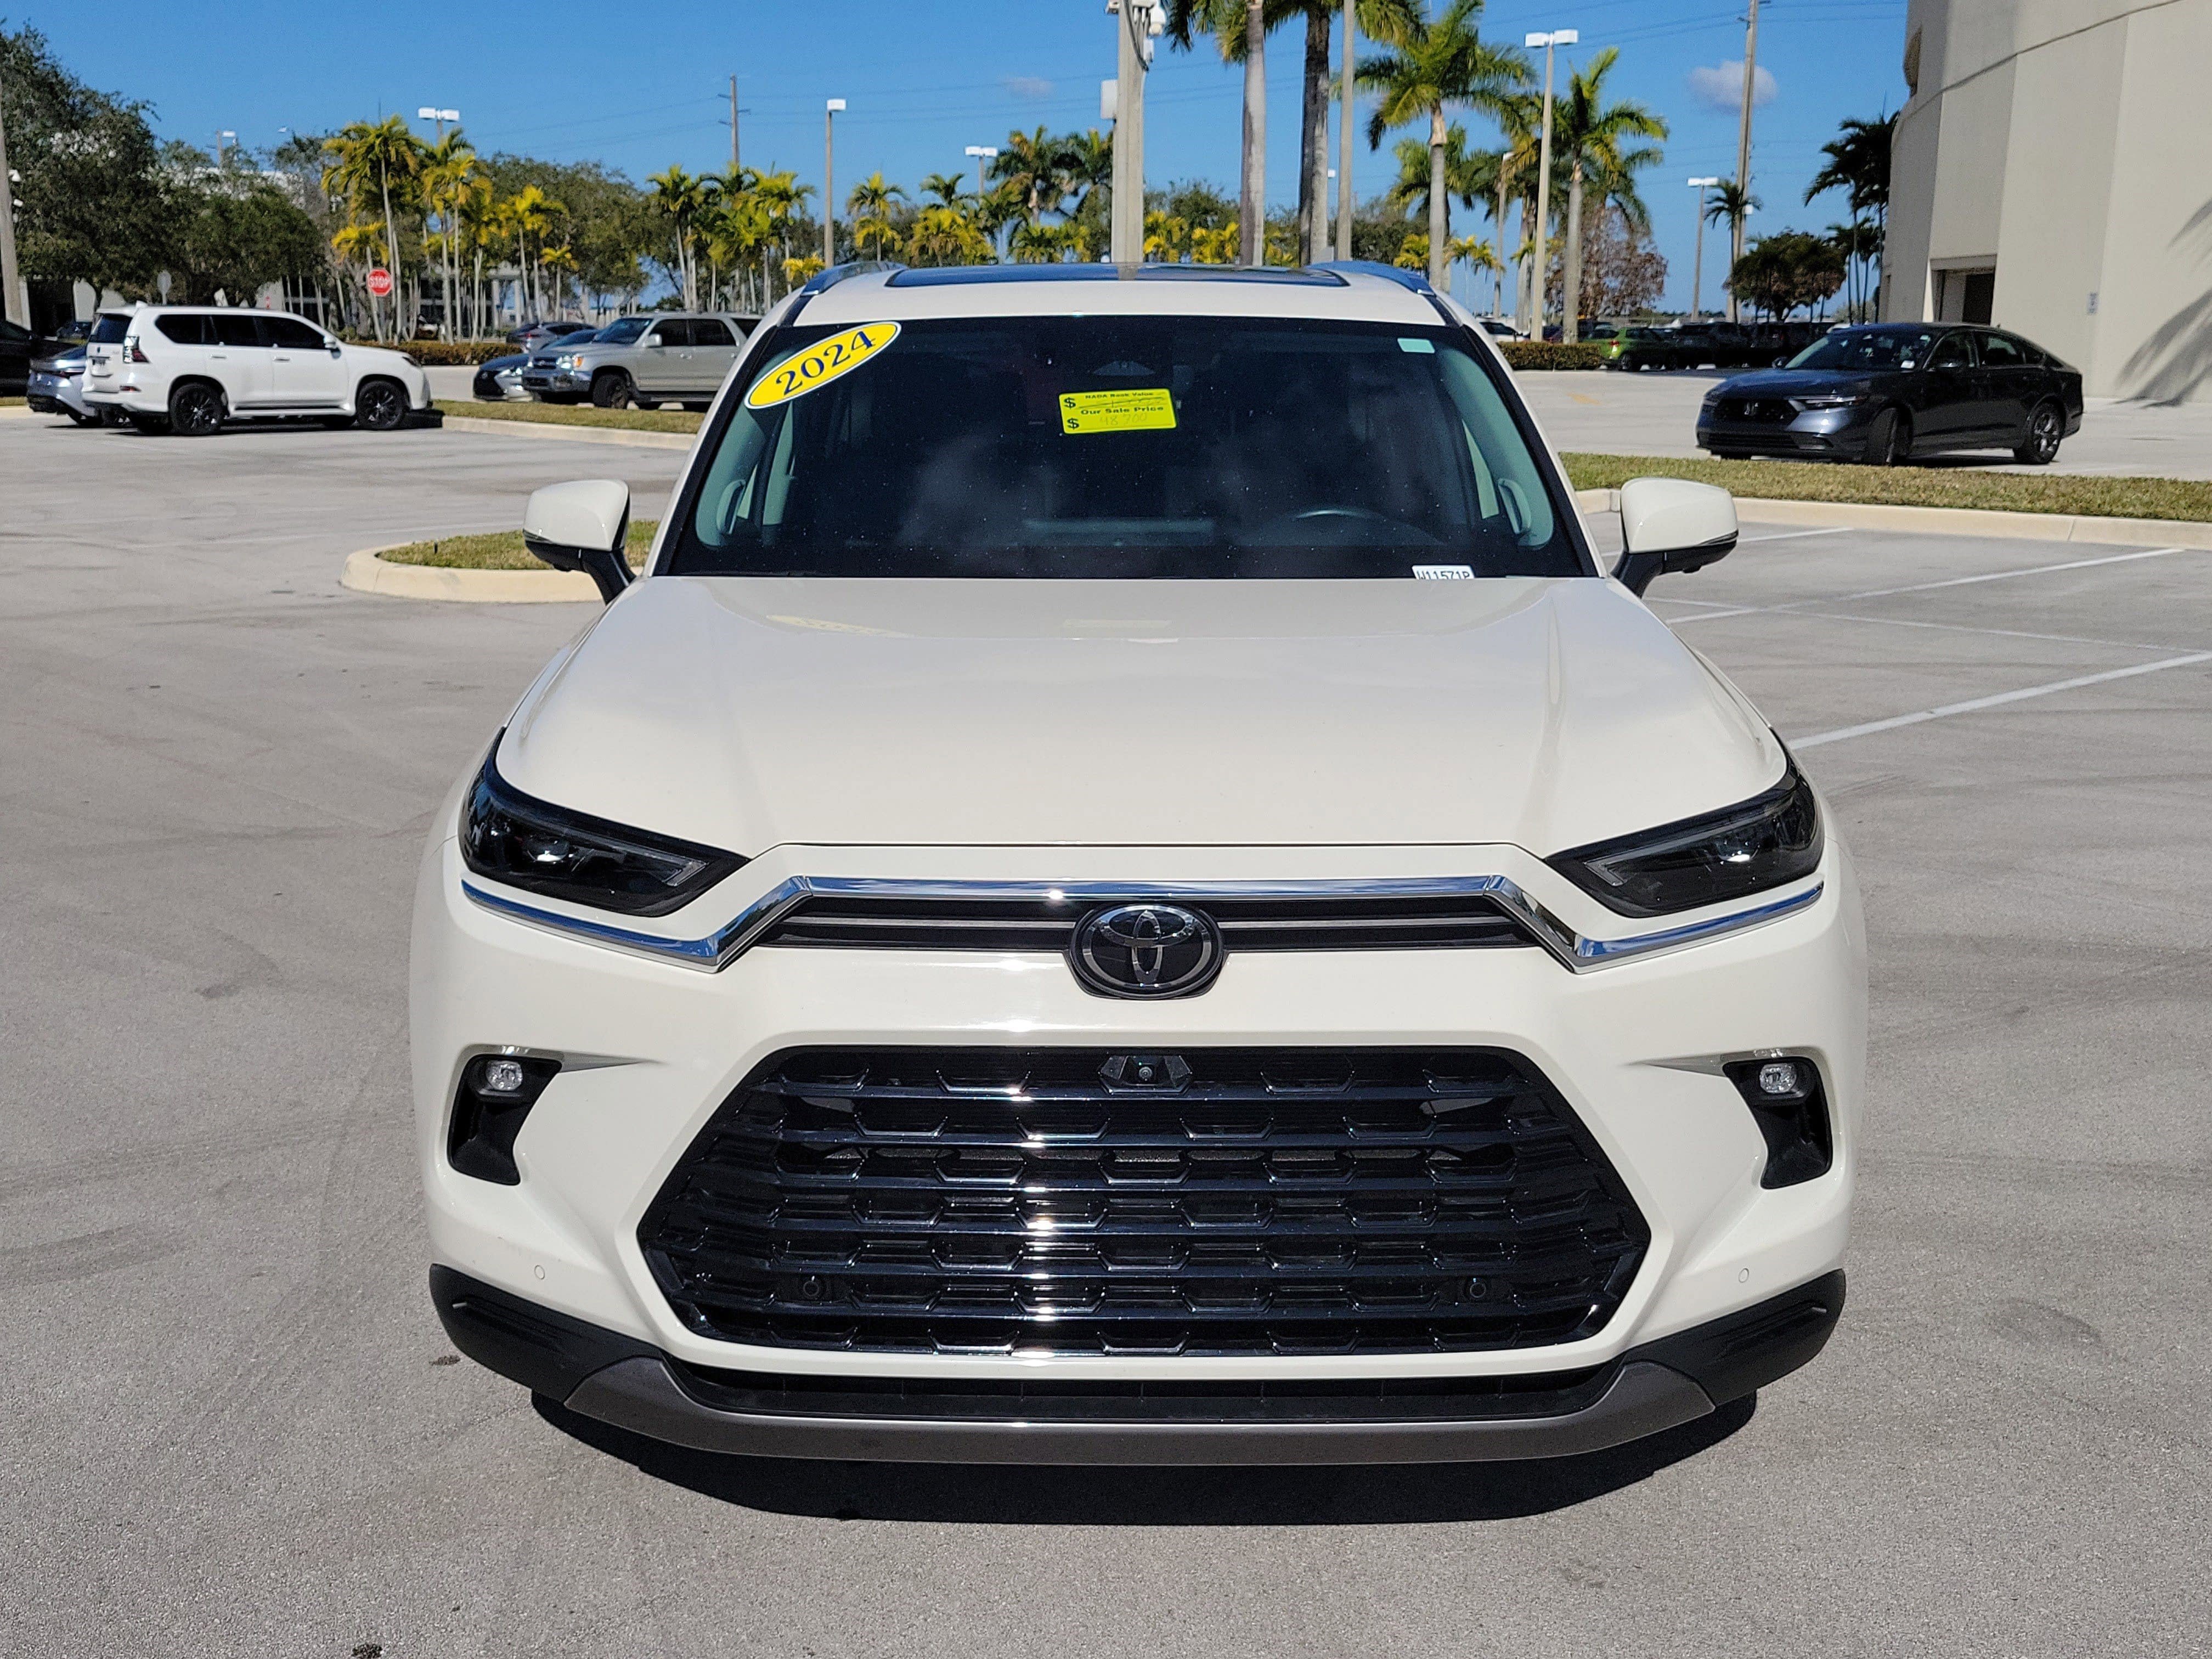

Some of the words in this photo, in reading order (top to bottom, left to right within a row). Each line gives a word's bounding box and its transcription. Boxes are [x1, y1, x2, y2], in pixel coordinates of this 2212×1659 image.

[369, 276, 391, 287] STOP
[775, 330, 876, 396] 2024
[1063, 397, 1077, 409] $
[1066, 417, 1080, 430] $
[1417, 570, 1470, 580] W11571P
